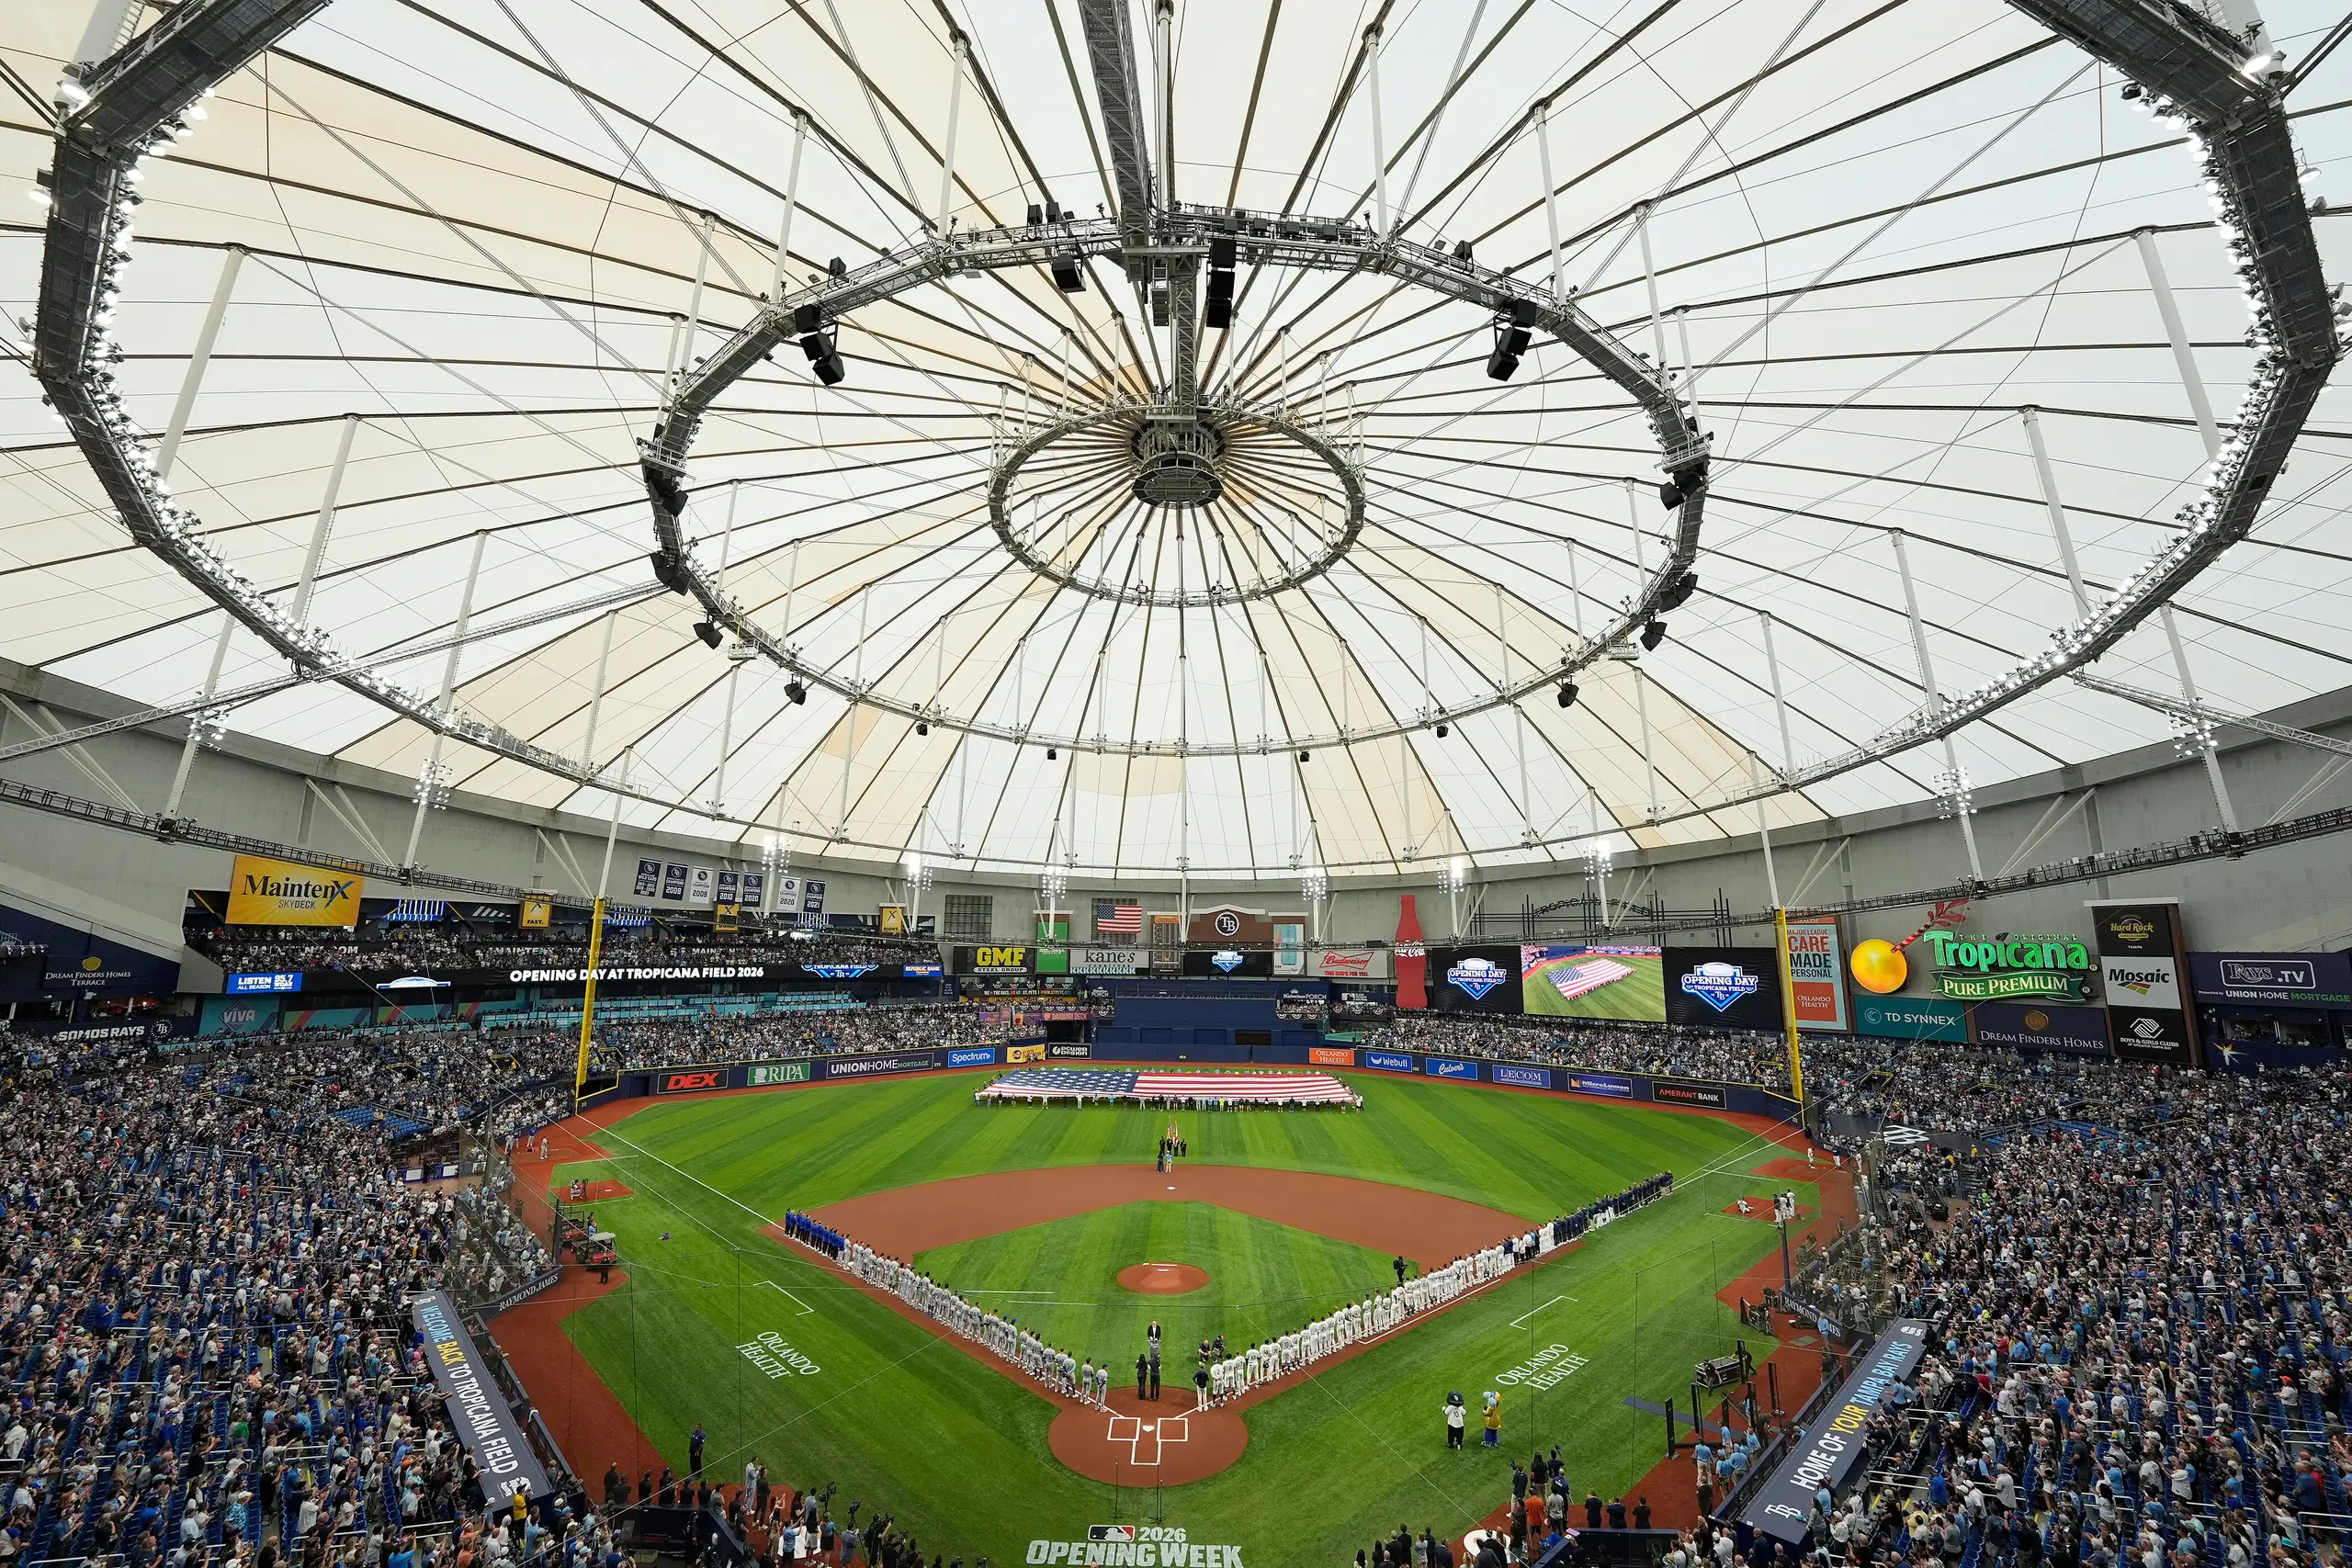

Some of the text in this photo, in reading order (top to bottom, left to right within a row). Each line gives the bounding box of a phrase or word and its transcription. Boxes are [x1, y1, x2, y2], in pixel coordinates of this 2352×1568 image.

[242, 874, 355, 909] MaintenX
[666, 886, 682, 894] 2008
[278, 899, 316, 909] SKYDECK
[1220, 916, 1235, 931] TB
[2110, 923, 2154, 933] Hard Rock
[1788, 936, 1830, 952] CARE
[1924, 930, 2089, 972] Tropicana
[977, 947, 1026, 966] GMF
[1325, 955, 1369, 964] Budweiser
[1790, 953, 1832, 968] MADE
[510, 967, 764, 982] OPENING DAY AT TROPICANA FIELD 2026
[1683, 976, 1756, 986] OPENING DAY
[1792, 969, 1833, 978] PERSONAL
[2109, 969, 2170, 983] Mosaic
[2228, 963, 2273, 983] RAYS
[1943, 975, 2067, 995] PURE PREMIUM
[2291, 993, 2351, 1002] MORTGAGE
[223, 1010, 254, 1023] VIVA
[1885, 1013, 1956, 1026] TD SYNNEX
[59, 1026, 145, 1041] SOMOS RAYS
[1981, 1031, 2103, 1049] DREAM FINDERS HOMES
[952, 1052, 986, 1063] Spectrum
[1383, 1057, 1407, 1067] Webull
[769, 1065, 804, 1082] RIPA
[1439, 1063, 1464, 1074] Culver's
[667, 1072, 720, 1090] DEX
[1582, 1081, 1629, 1090] MicroLumen
[539, 1087, 556, 1100] 162
[1659, 1089, 1719, 1102] AMERANT BANK
[499, 1273, 559, 1311] RAYMOND JAMES
[420, 1306, 454, 1343] WELCOME
[436, 1341, 466, 1366] BACK
[757, 1331, 821, 1375] ORLANDO
[1883, 1341, 1913, 1362] RAYS
[735, 1341, 791, 1379] HEALTH
[1495, 1344, 1569, 1385] ORLANDO
[447, 1364, 473, 1378] TO
[1524, 1353, 1590, 1391] HEALTH
[1871, 1359, 1899, 1378] BAY
[1849, 1377, 1889, 1406] TAMPA
[454, 1378, 501, 1440] TROPICANA
[1829, 1405, 1869, 1435] YOUR
[1818, 1433, 1847, 1452] OF
[481, 1437, 519, 1474] FIELD
[1790, 1450, 1837, 1490] HOME
[1764, 1504, 1801, 1519] TB
[1138, 1527, 1187, 1543] 2026
[1026, 1540, 1244, 1568] OPENING WEEK
